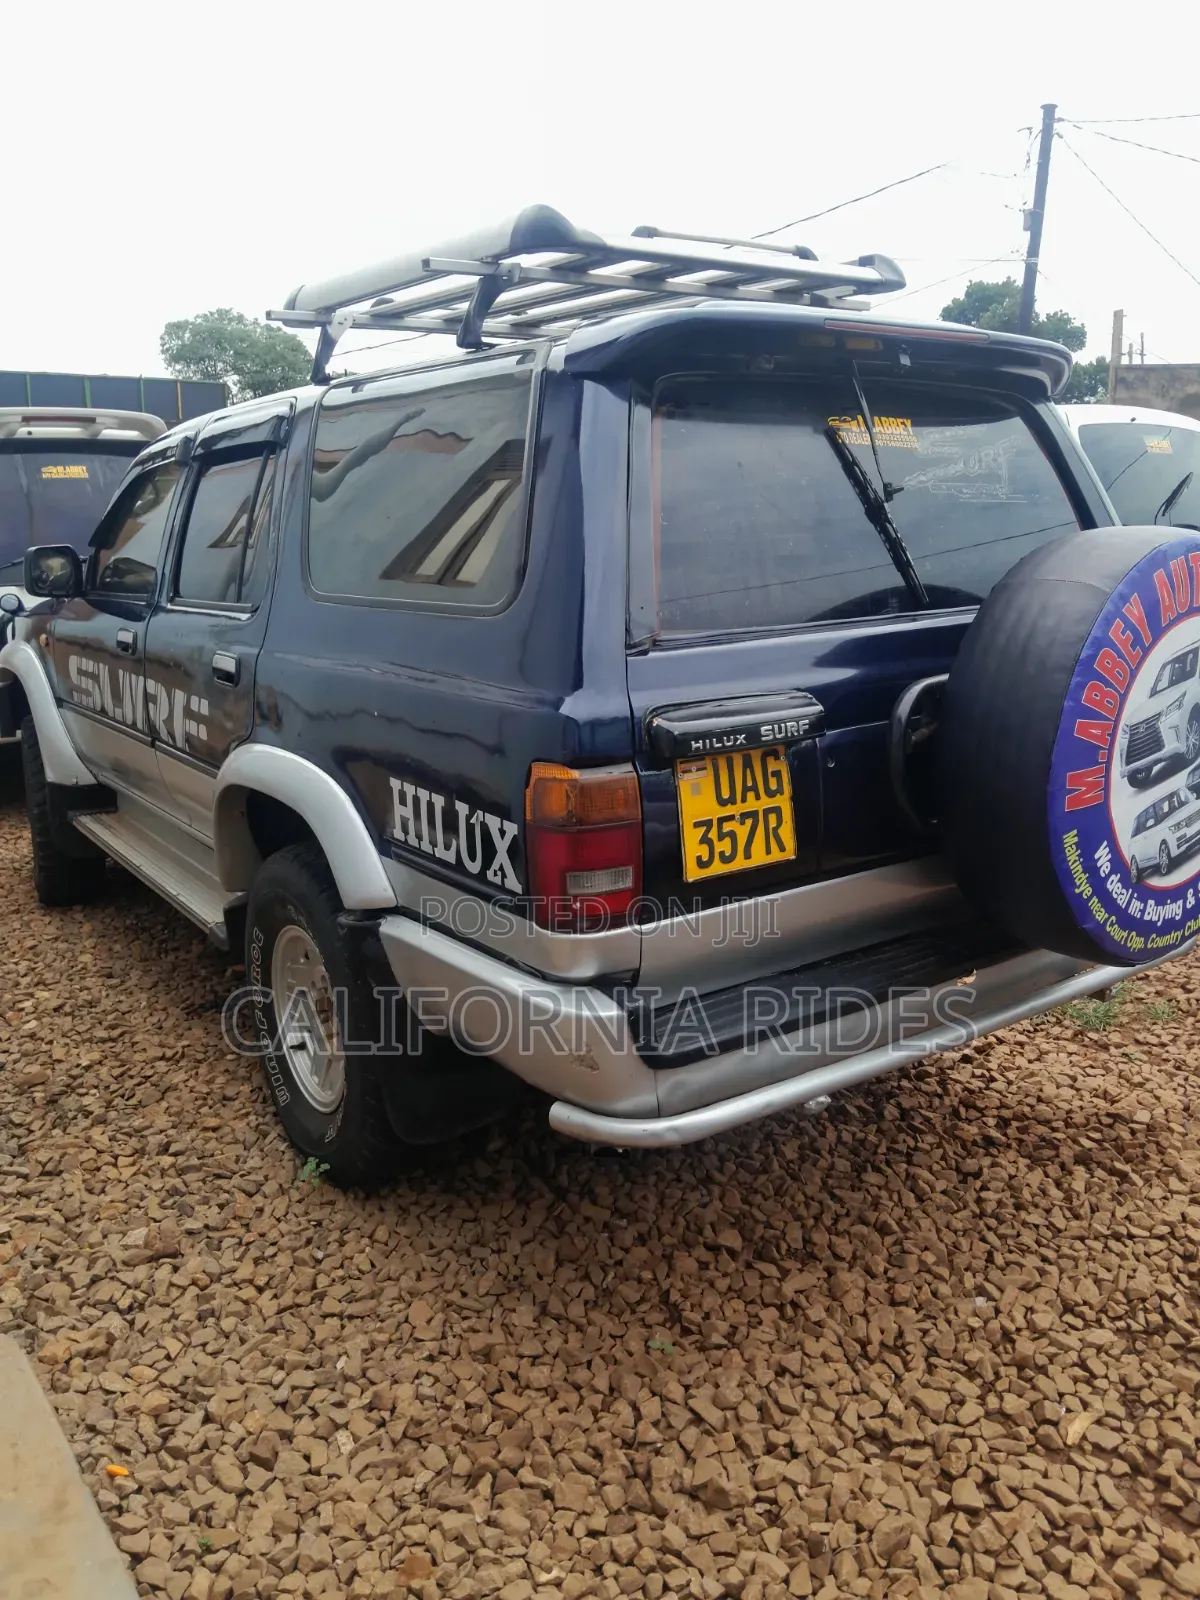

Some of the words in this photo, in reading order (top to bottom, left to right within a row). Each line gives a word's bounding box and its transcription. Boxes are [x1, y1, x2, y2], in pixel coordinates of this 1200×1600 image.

[69, 655, 209, 752] SURF
[691, 734, 747, 751] HILUX
[760, 719, 809, 741] SURF
[1065, 592, 1152, 812] M.ABBEY
[711, 749, 785, 807] UAG
[389, 776, 523, 895] HILUX
[693, 805, 787, 869] 357R
[1062, 829, 1093, 899] Makindye
[1088, 895, 1109, 924] near
[1105, 915, 1128, 945] Court
[1127, 931, 1145, 952] Opp.
[1147, 928, 1183, 948] Country
[1184, 914, 1200, 937] Clu
[1094, 840, 1112, 877] We
[1106, 873, 1132, 909] deal
[1128, 893, 1144, 918] in:
[1144, 899, 1183, 926] Buying
[1186, 888, 1195, 908] &
